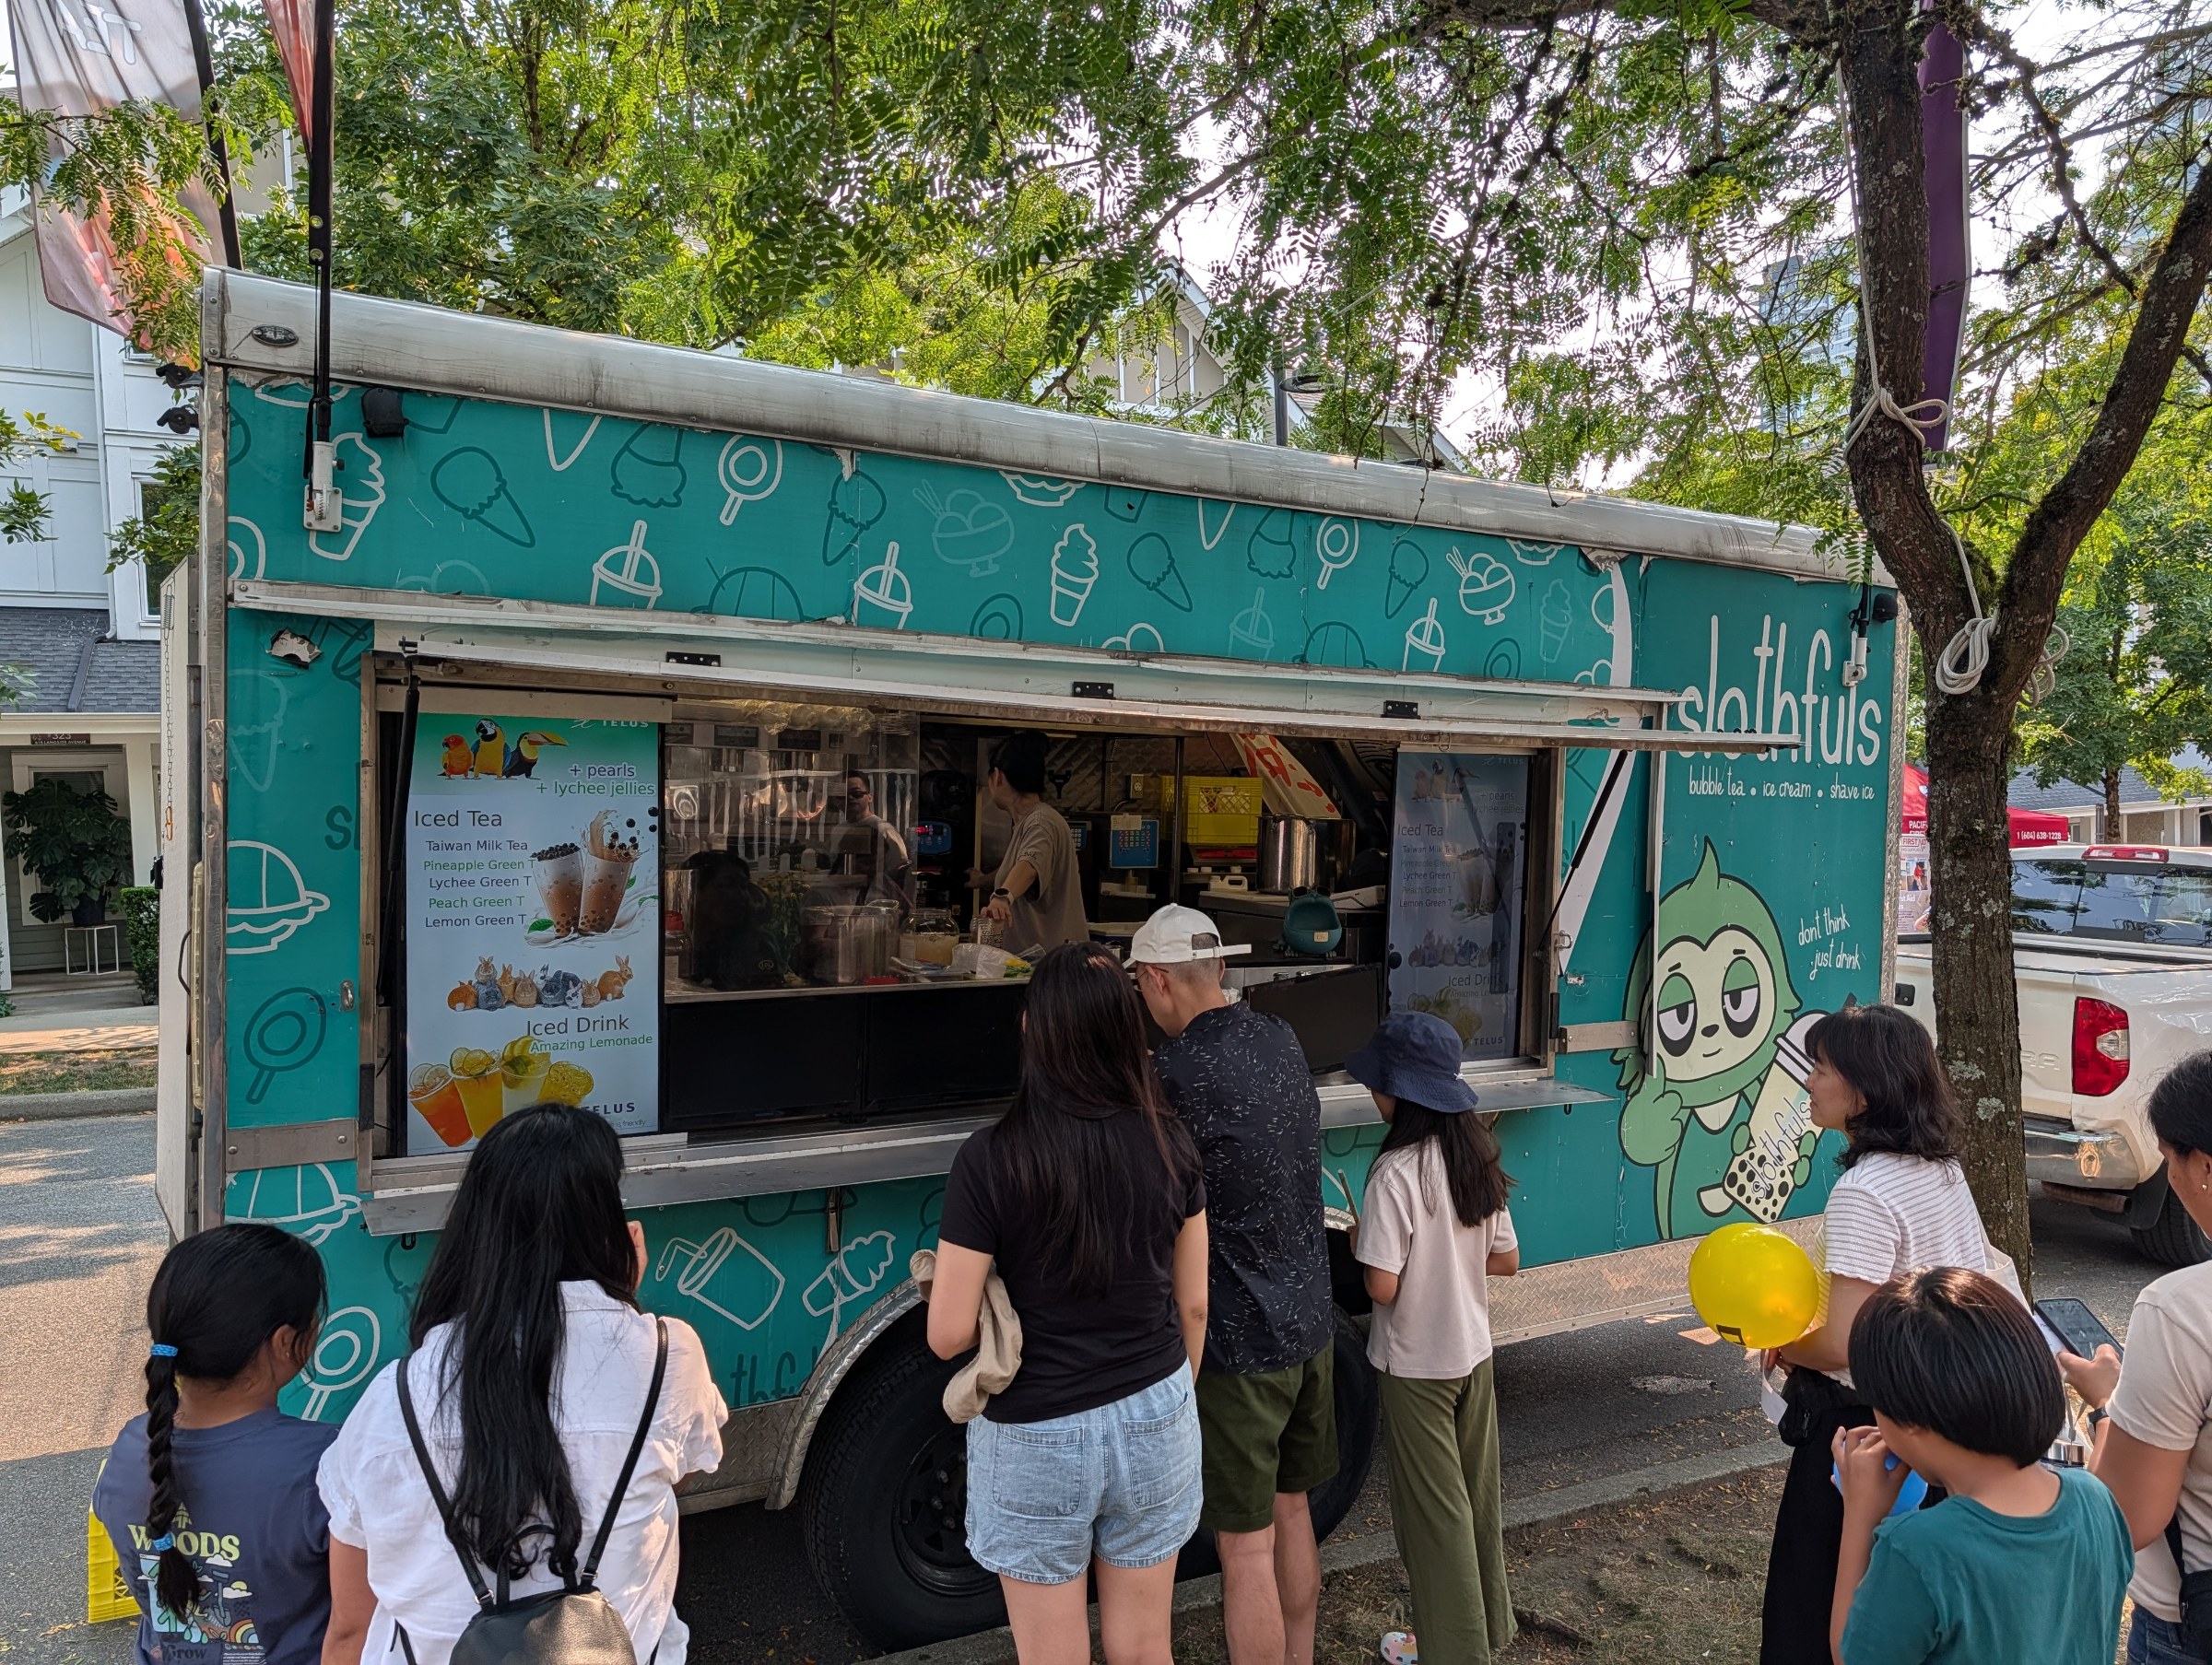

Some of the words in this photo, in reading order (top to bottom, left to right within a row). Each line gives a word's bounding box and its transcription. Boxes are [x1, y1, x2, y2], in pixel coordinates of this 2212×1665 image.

[1677, 614, 1882, 767] slothfuls
[587, 764, 635, 780] pearls
[554, 780, 606, 797] lychee
[609, 780, 655, 797] jellies
[1688, 765, 1724, 795] bubble
[1727, 766, 1746, 796] tea
[1762, 780, 1777, 797] ice
[1779, 781, 1811, 798] cream
[1830, 771, 1860, 800] shave
[1862, 784, 1876, 800] ice
[1489, 791, 1514, 802] pearls
[1500, 803, 1524, 815] jellies
[414, 810, 459, 827] Iced
[467, 810, 503, 827] Tea
[1909, 820, 1928, 829] PACIF
[1397, 824, 1421, 837] Iced
[1426, 824, 1443, 837] Tea
[2021, 830, 2036, 840] (604)
[2036, 831, 2062, 840] 638-1228
[425, 839, 472, 851] Taiwan
[477, 839, 502, 850] Milk
[506, 839, 528, 850] Tea
[1403, 845, 1427, 853] Taiwan
[1429, 845, 1442, 853] Milk
[1444, 845, 1456, 853] Tea
[424, 860, 484, 873] Pineapple
[488, 860, 524, 870] Green
[528, 859, 535, 869] T
[429, 877, 476, 891] Lychee
[479, 876, 519, 887] Green
[523, 875, 532, 886] T
[1403, 871, 1428, 882] Lychee
[1429, 871, 1451, 881] Green
[1402, 885, 1423, 895] Peach
[1425, 885, 1446, 895] Green
[429, 897, 468, 909] Peach
[473, 897, 512, 908] Green
[516, 896, 525, 906] T
[1399, 898, 1423, 908] Lemon
[1425, 898, 1446, 908] Green
[425, 917, 470, 928] Lemon
[475, 915, 514, 926] Green
[517, 913, 527, 924] T
[1798, 909, 1822, 946] dont
[1823, 903, 1851, 936] think
[1809, 937, 1834, 980] just
[1836, 941, 1861, 970] drink
[1448, 974, 1471, 987] Iced
[526, 1017, 569, 1037] Iced
[576, 1014, 629, 1034] Drink
[530, 1040, 585, 1053] Amazing
[589, 1034, 653, 1049] Lemonade
[1475, 1036, 1503, 1045] TELUS
[623, 1119, 646, 1128] friendly
[1747, 1096, 1813, 1200] slothfuls
[127, 1524, 241, 1562] WODS
